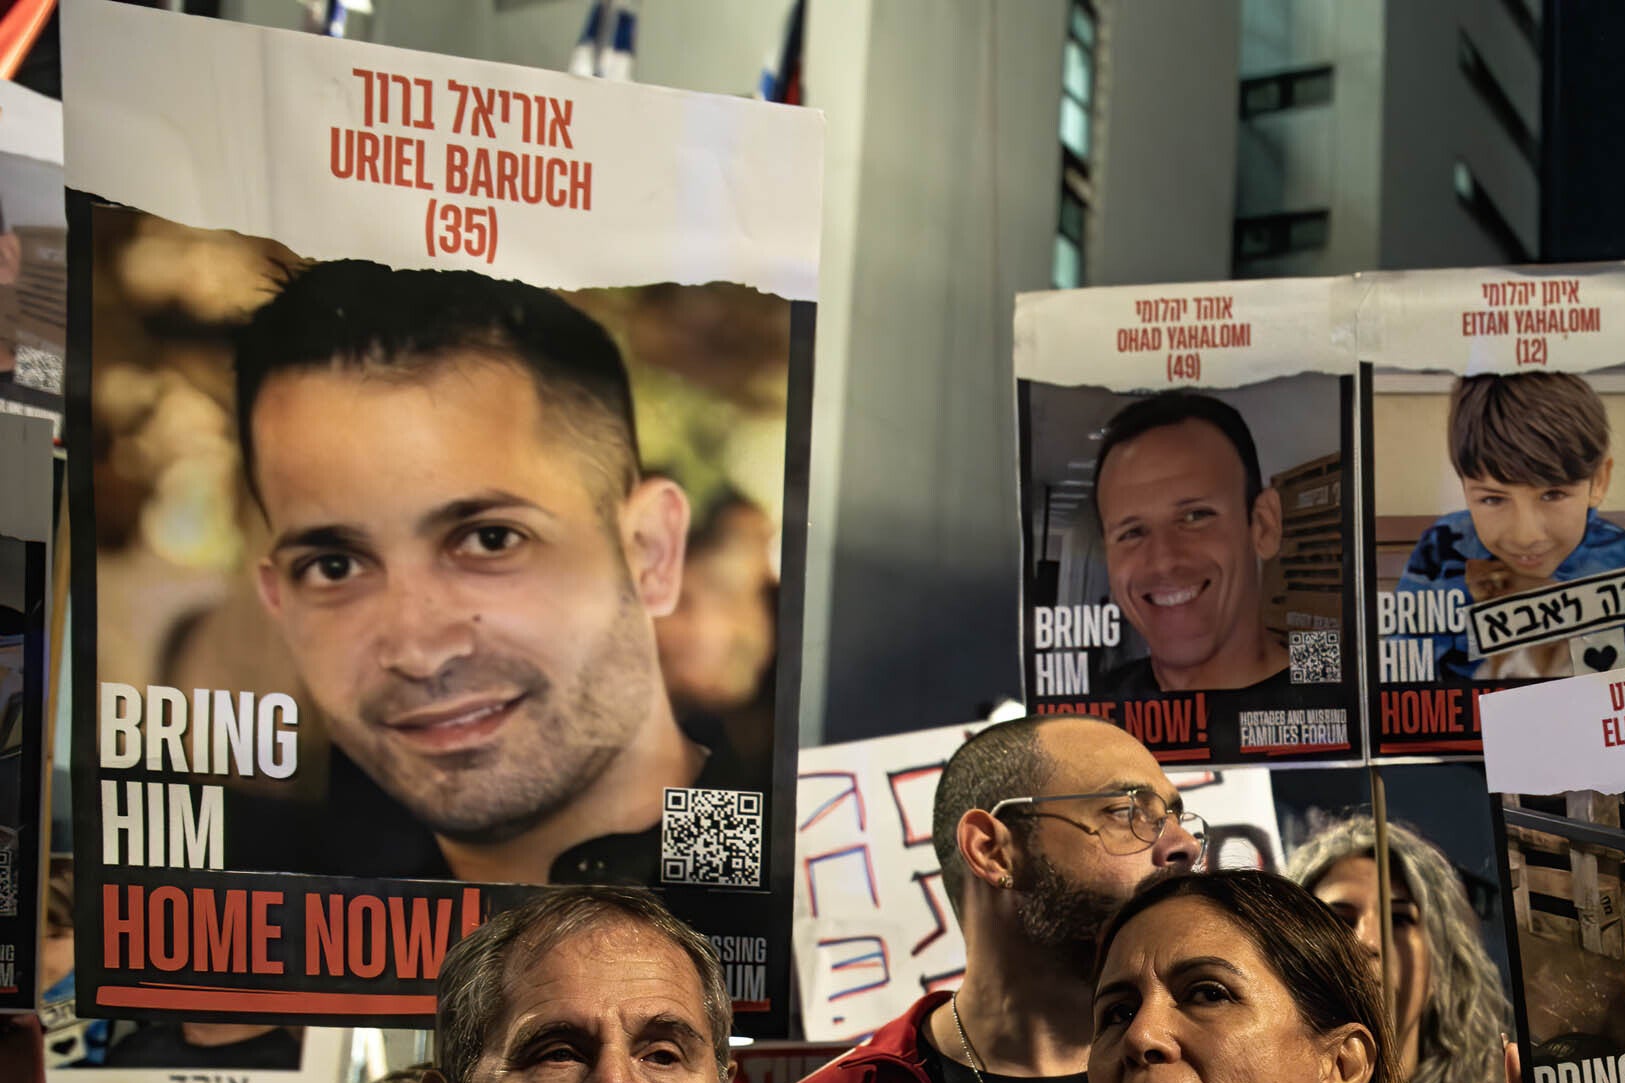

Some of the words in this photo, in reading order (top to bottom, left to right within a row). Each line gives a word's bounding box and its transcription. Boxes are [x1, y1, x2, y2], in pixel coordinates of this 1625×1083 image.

[353, 68, 435, 130] ברוך
[448, 78, 573, 149] אוריאל
[330, 127, 432, 190] URIEL
[445, 146, 592, 210] BARUCH
[425, 198, 498, 264] (35)
[1136, 298, 1189, 322] יהלומי
[1194, 296, 1233, 320] אוהד
[1482, 281, 1536, 305] יהלומי
[1544, 279, 1580, 304] איתן
[1116, 328, 1162, 353] OHAD
[1167, 322, 1250, 350] YAHALOMI
[1462, 311, 1511, 338] EITAN
[1515, 308, 1601, 335] YAHALOMI
[1166, 352, 1201, 383] (49)
[1515, 337, 1548, 366] (12)
[1034, 605, 1120, 650] BRING
[1377, 589, 1466, 635] BRING
[1484, 592, 1583, 644] לאבא
[1036, 651, 1090, 696] HIM
[1378, 638, 1435, 684] HIM
[100, 681, 299, 780] BRING
[1287, 709, 1305, 725] AND
[1381, 689, 1466, 735] HOME
[1241, 725, 1299, 747] FAMILIES
[1301, 723, 1348, 745] FORUM
[101, 780, 225, 871] HIM
[102, 884, 284, 976] HOME
